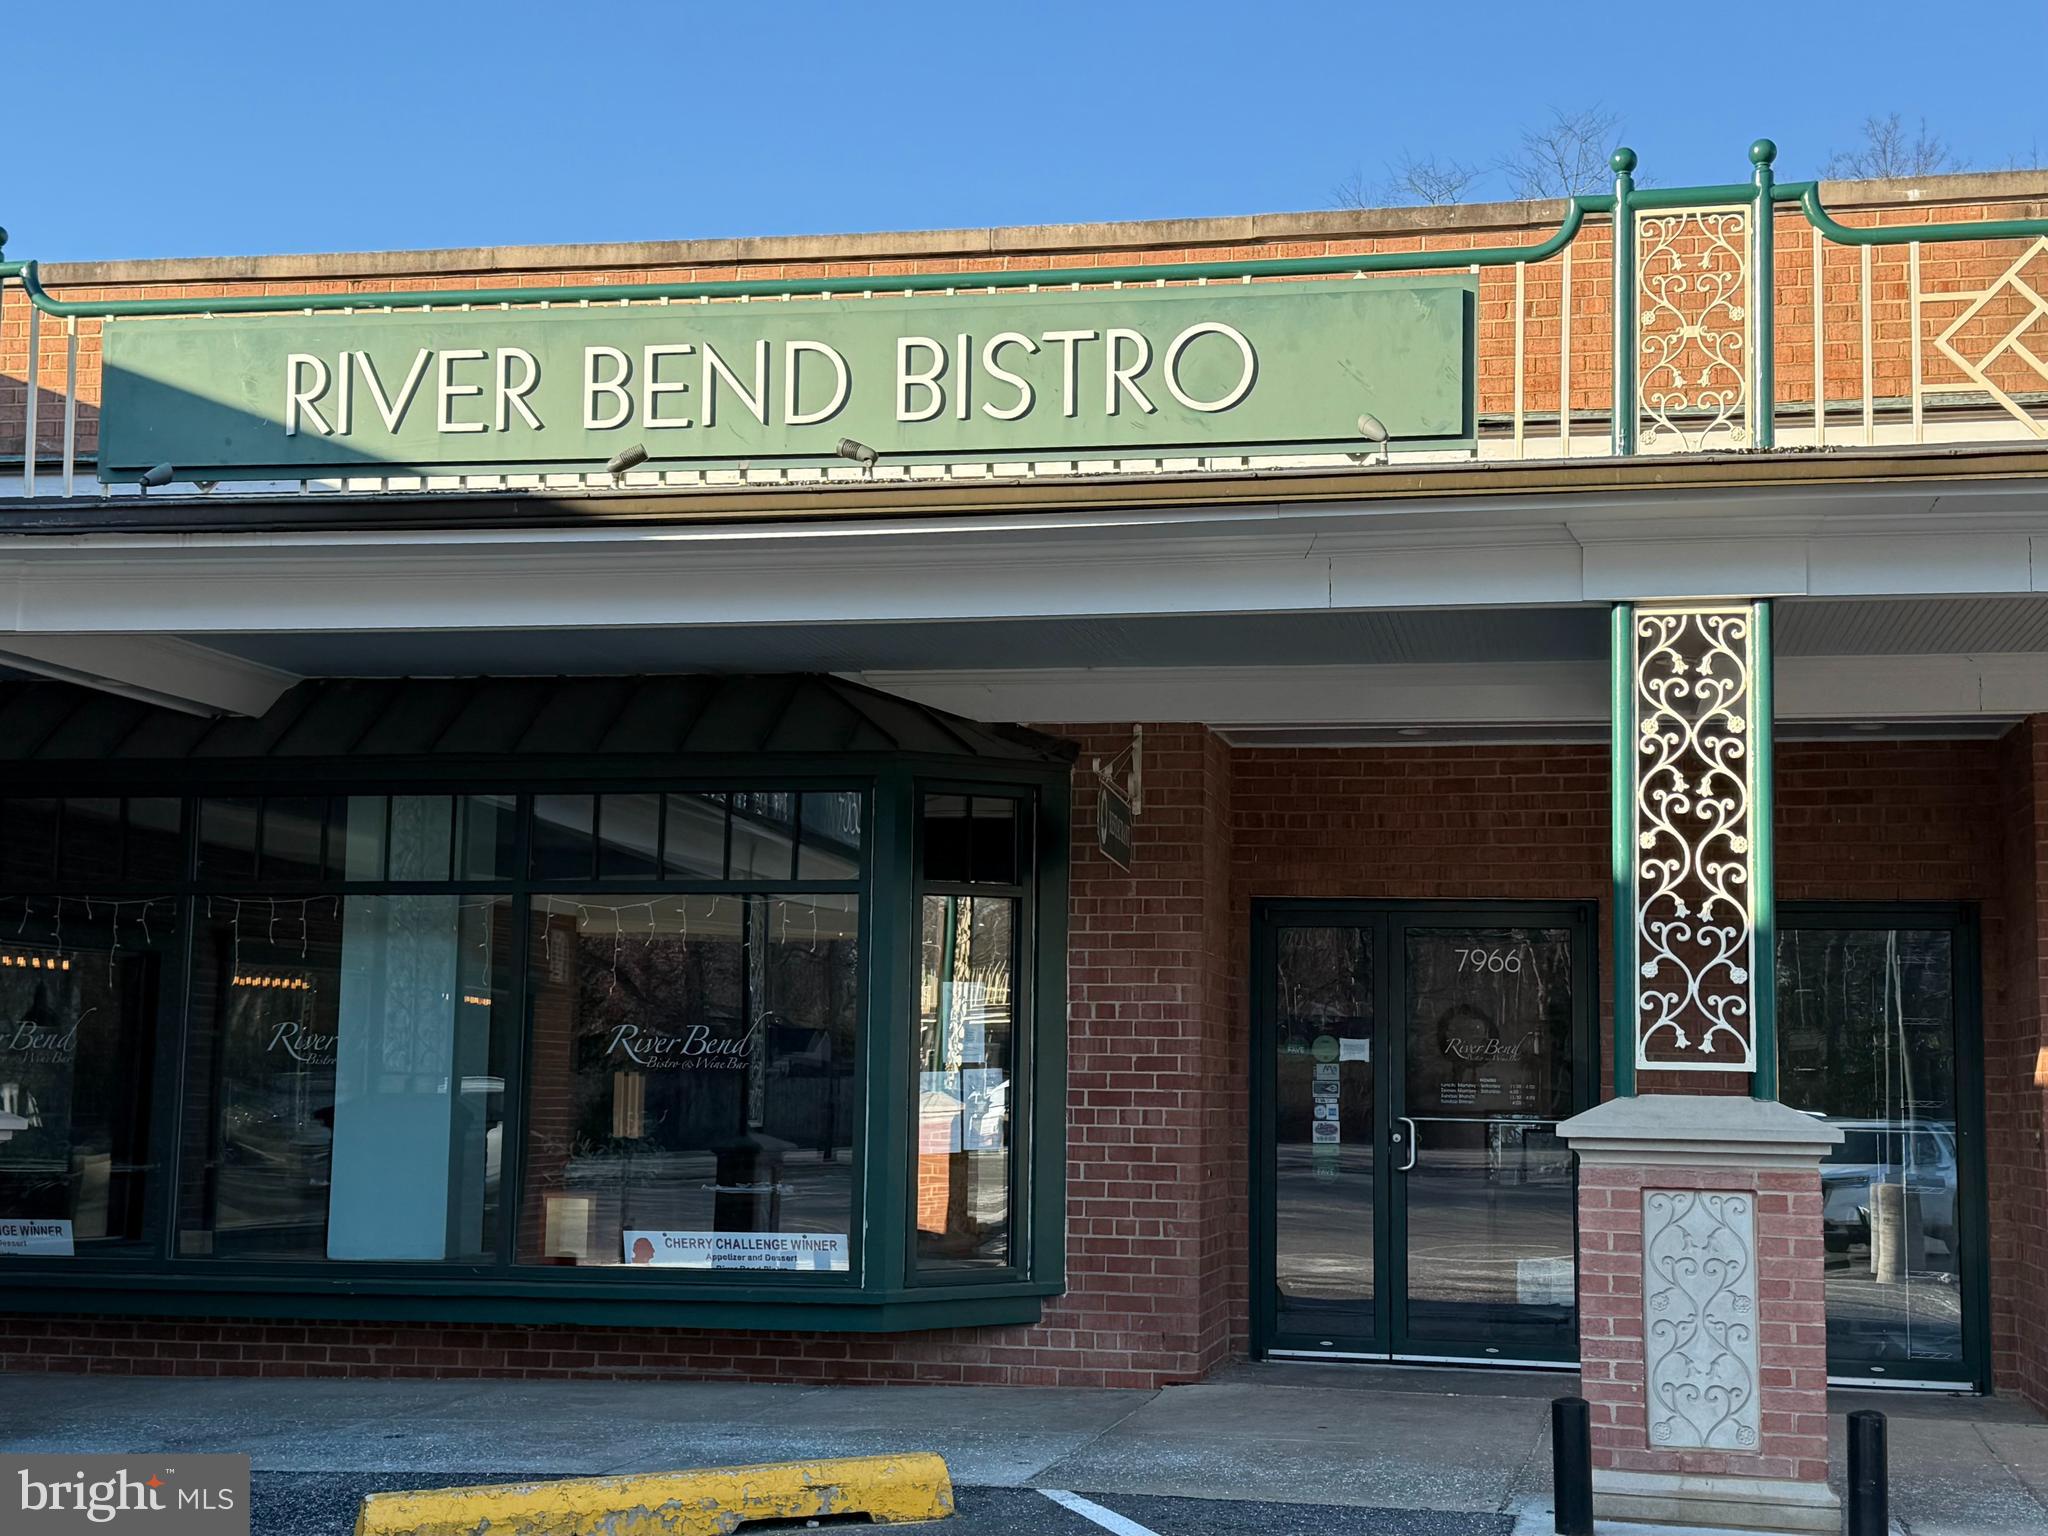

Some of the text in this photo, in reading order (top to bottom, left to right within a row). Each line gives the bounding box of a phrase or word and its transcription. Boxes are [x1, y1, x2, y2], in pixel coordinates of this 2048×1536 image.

[286, 321, 1259, 437] RIVER BEND BISTRO
[1454, 948, 1521, 973] 7966
[8, 1007, 97, 1051] Bend
[267, 1021, 340, 1062] River
[605, 1010, 773, 1065] River Bend
[1444, 1031, 1533, 1060] River Bend
[306, 1052, 338, 1066] Bistr
[647, 1055, 681, 1069] Bistro
[695, 1056, 725, 1070] Wine
[726, 1056, 750, 1070] Bar
[20, 1225, 63, 1236] WINNER
[664, 1236, 838, 1252] CHERRY CHALLENGE WINNER
[706, 1252, 798, 1262] Appetizer and Dessert
